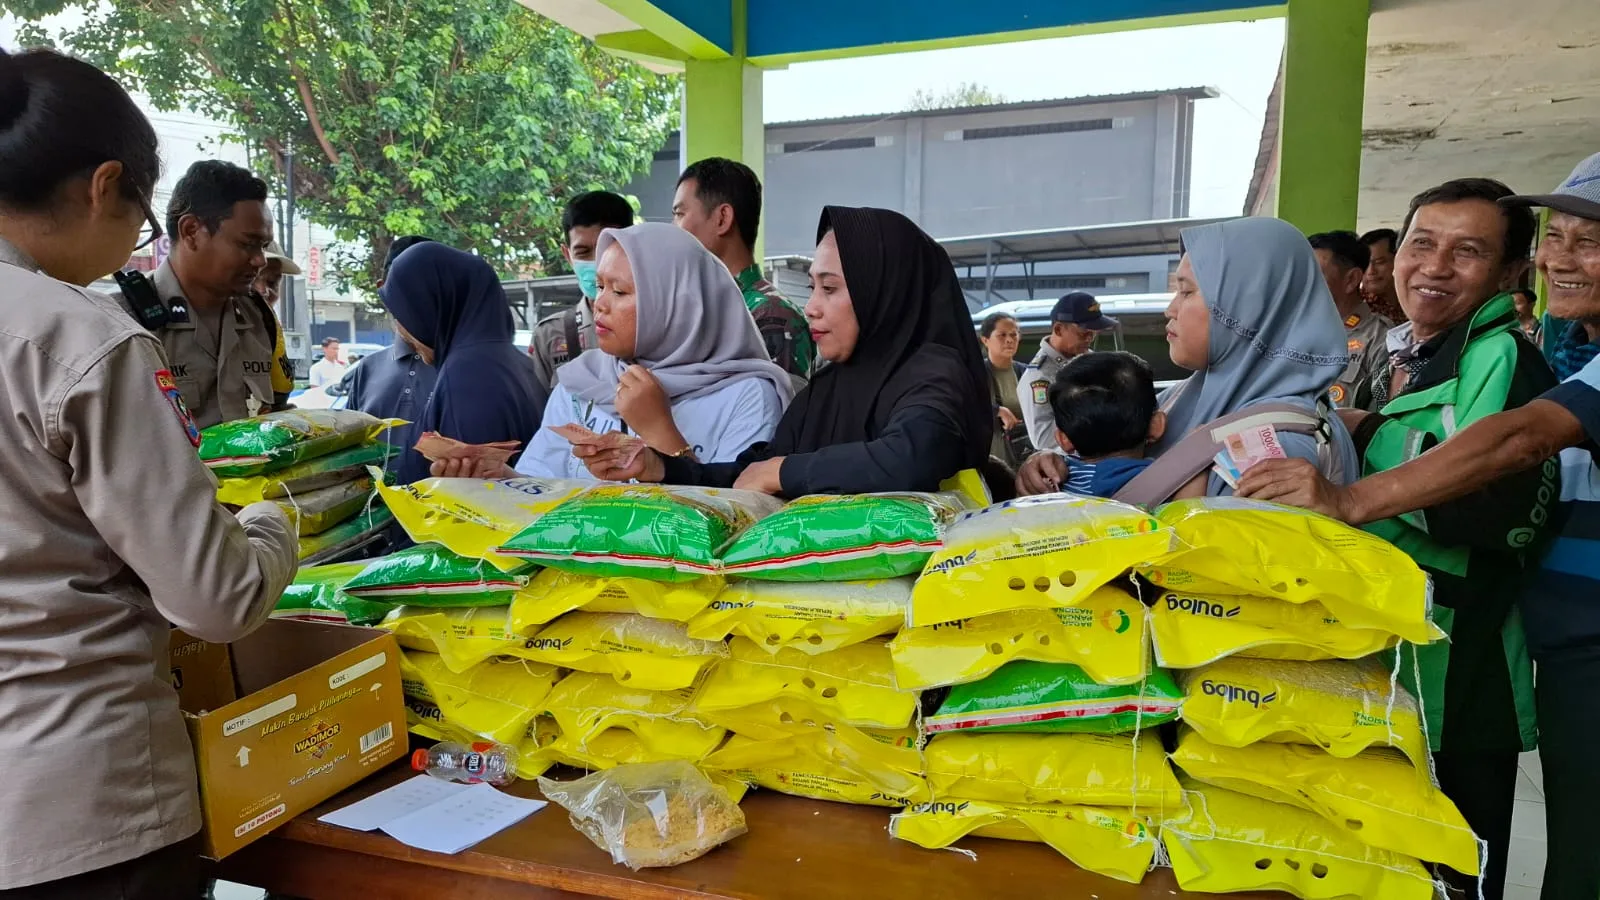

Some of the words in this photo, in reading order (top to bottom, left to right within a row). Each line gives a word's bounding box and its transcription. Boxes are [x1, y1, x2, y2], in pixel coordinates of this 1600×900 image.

[1201, 679, 1261, 709] bulog
[226, 717, 246, 732] MOTIF
[295, 724, 340, 752] WADIMOR
[257, 807, 283, 825] POTONG
